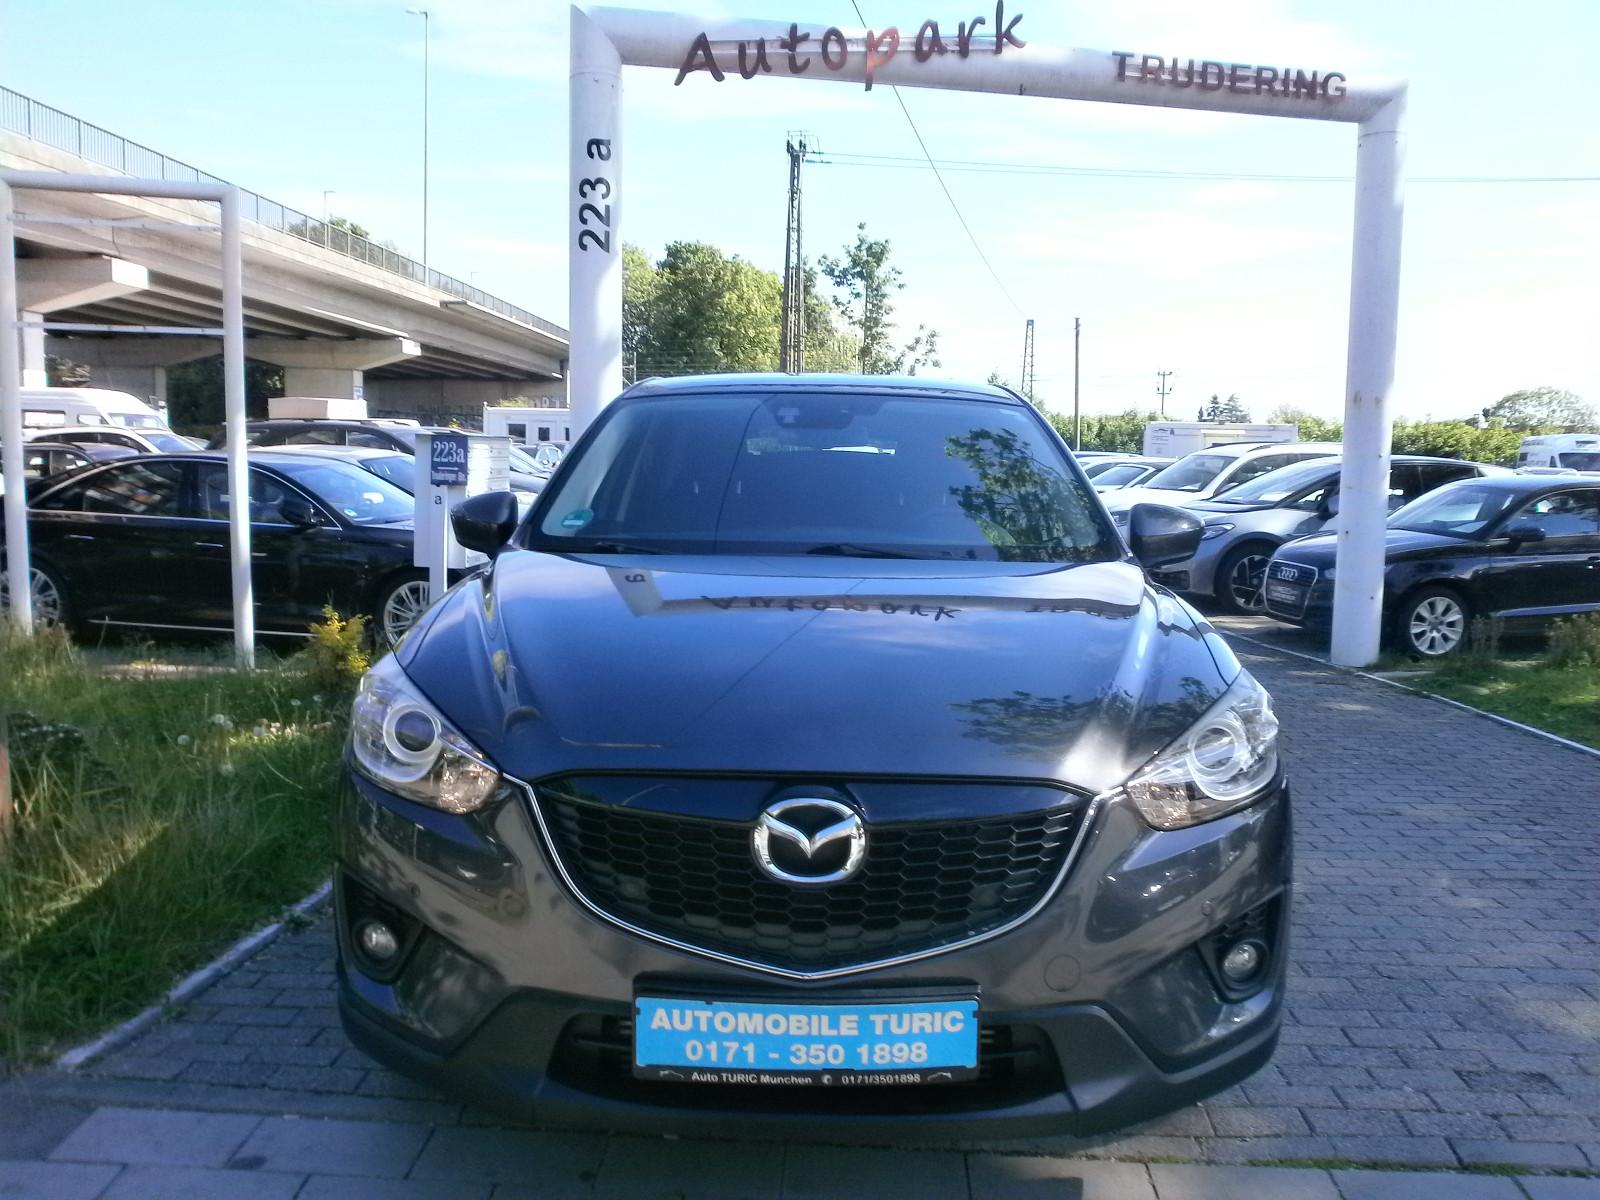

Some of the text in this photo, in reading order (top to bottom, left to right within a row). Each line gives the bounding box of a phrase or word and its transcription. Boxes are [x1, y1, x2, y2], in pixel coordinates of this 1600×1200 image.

[674, 0, 1027, 91] Autopark
[1111, 50, 1348, 101] TRUDERING
[578, 137, 612, 253] 223 a
[432, 441, 465, 463] 223a
[434, 495, 442, 505] a
[650, 1007, 965, 1037] AUTOMOBILE TURIC
[684, 1039, 757, 1064] 0171
[789, 1043, 845, 1066] 350
[856, 1041, 929, 1065] 1898
[691, 1072, 719, 1083] Auto
[721, 1072, 758, 1084] TURIC
